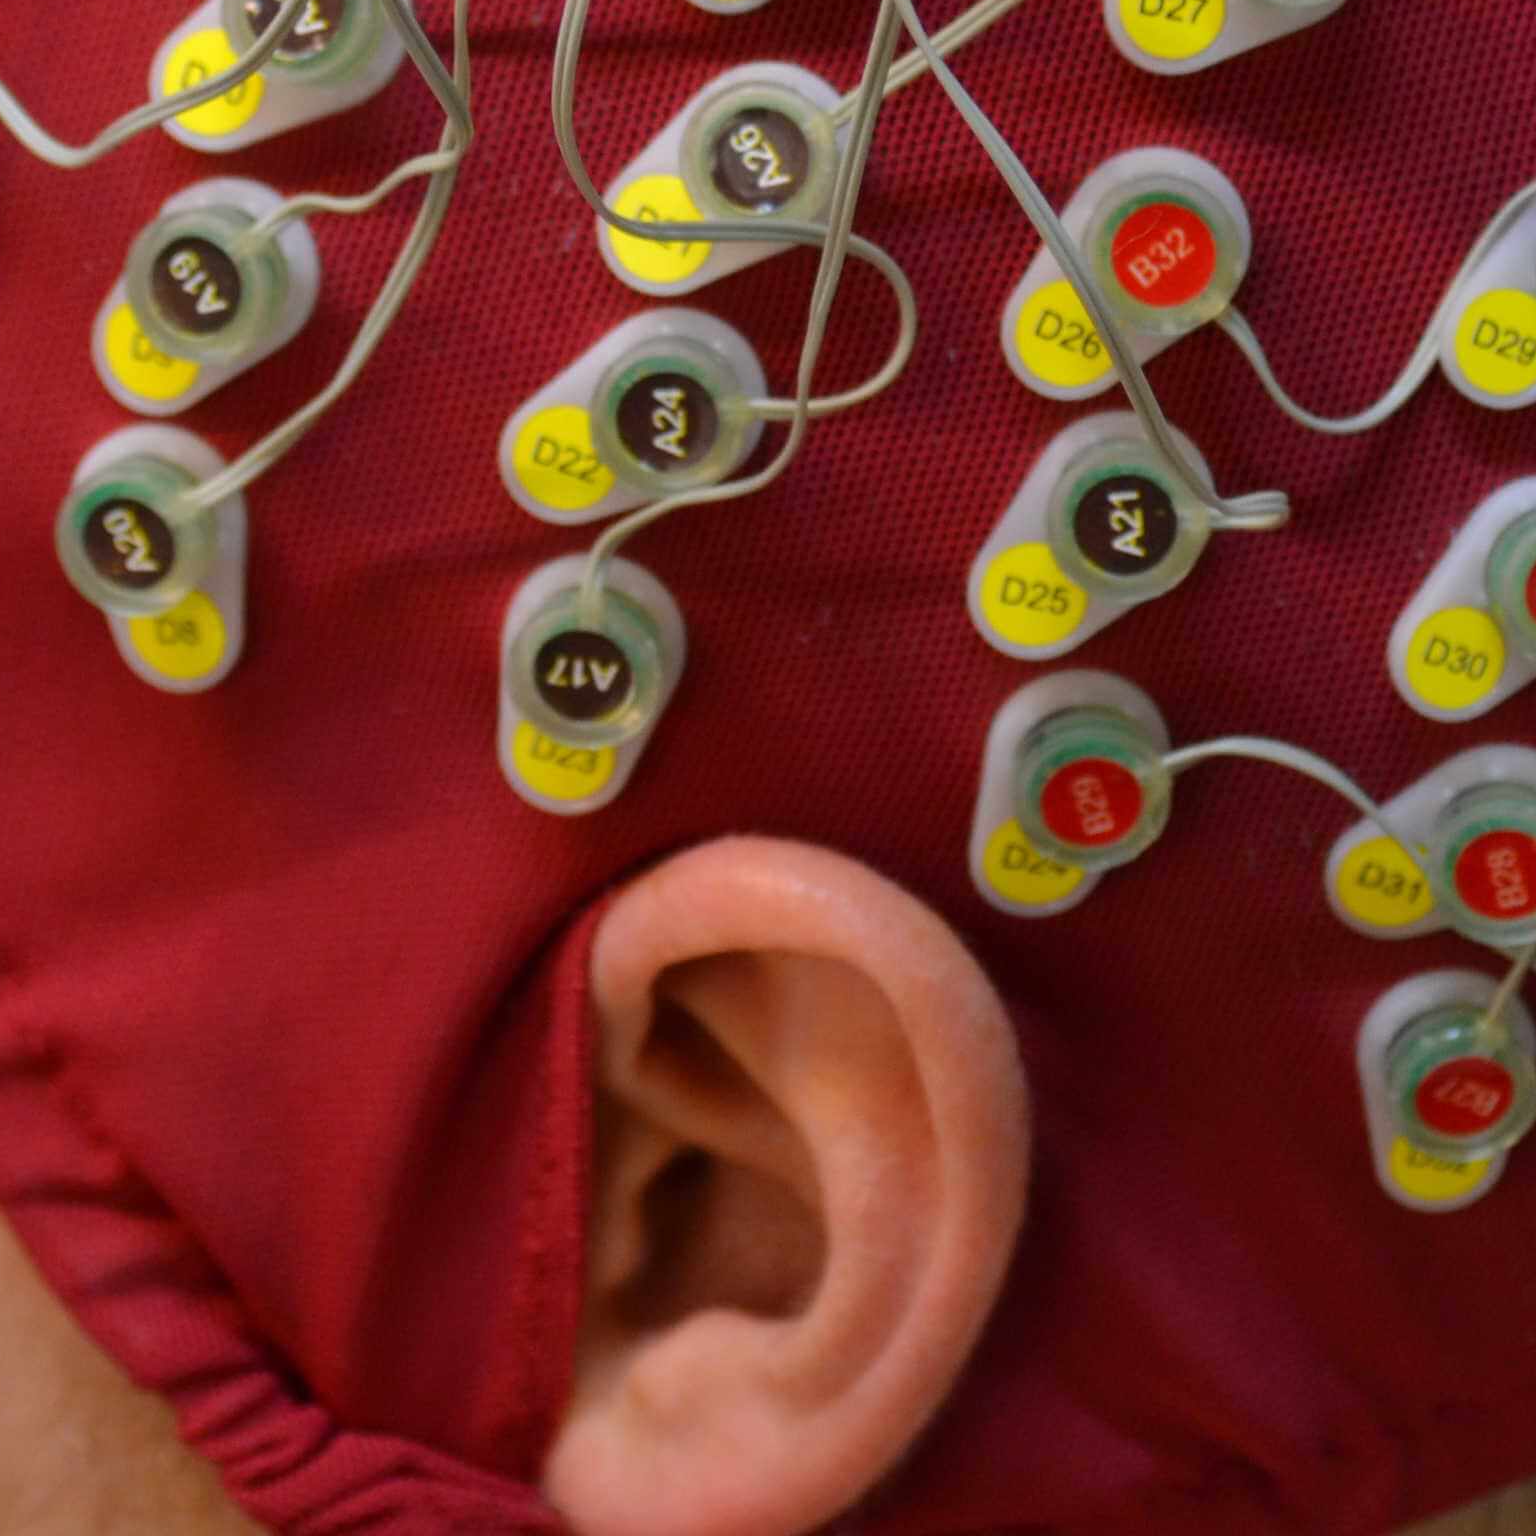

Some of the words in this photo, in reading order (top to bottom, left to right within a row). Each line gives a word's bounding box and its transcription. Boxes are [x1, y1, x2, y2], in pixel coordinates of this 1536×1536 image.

[730, 124, 790, 191] A26
[169, 250, 227, 316] A19
[1129, 228, 1195, 290] B32
[1034, 309, 1102, 361] D26
[654, 387, 687, 458] A24
[531, 436, 600, 485] D22
[102, 506, 160, 572] A20
[1107, 489, 1147, 558] A21
[999, 575, 1070, 615] D25
[547, 656, 618, 692] A17
[1423, 634, 1490, 682] D30
[1071, 776, 1116, 837] B29
[1358, 861, 1424, 904] D31
[1486, 848, 1530, 910] B28
